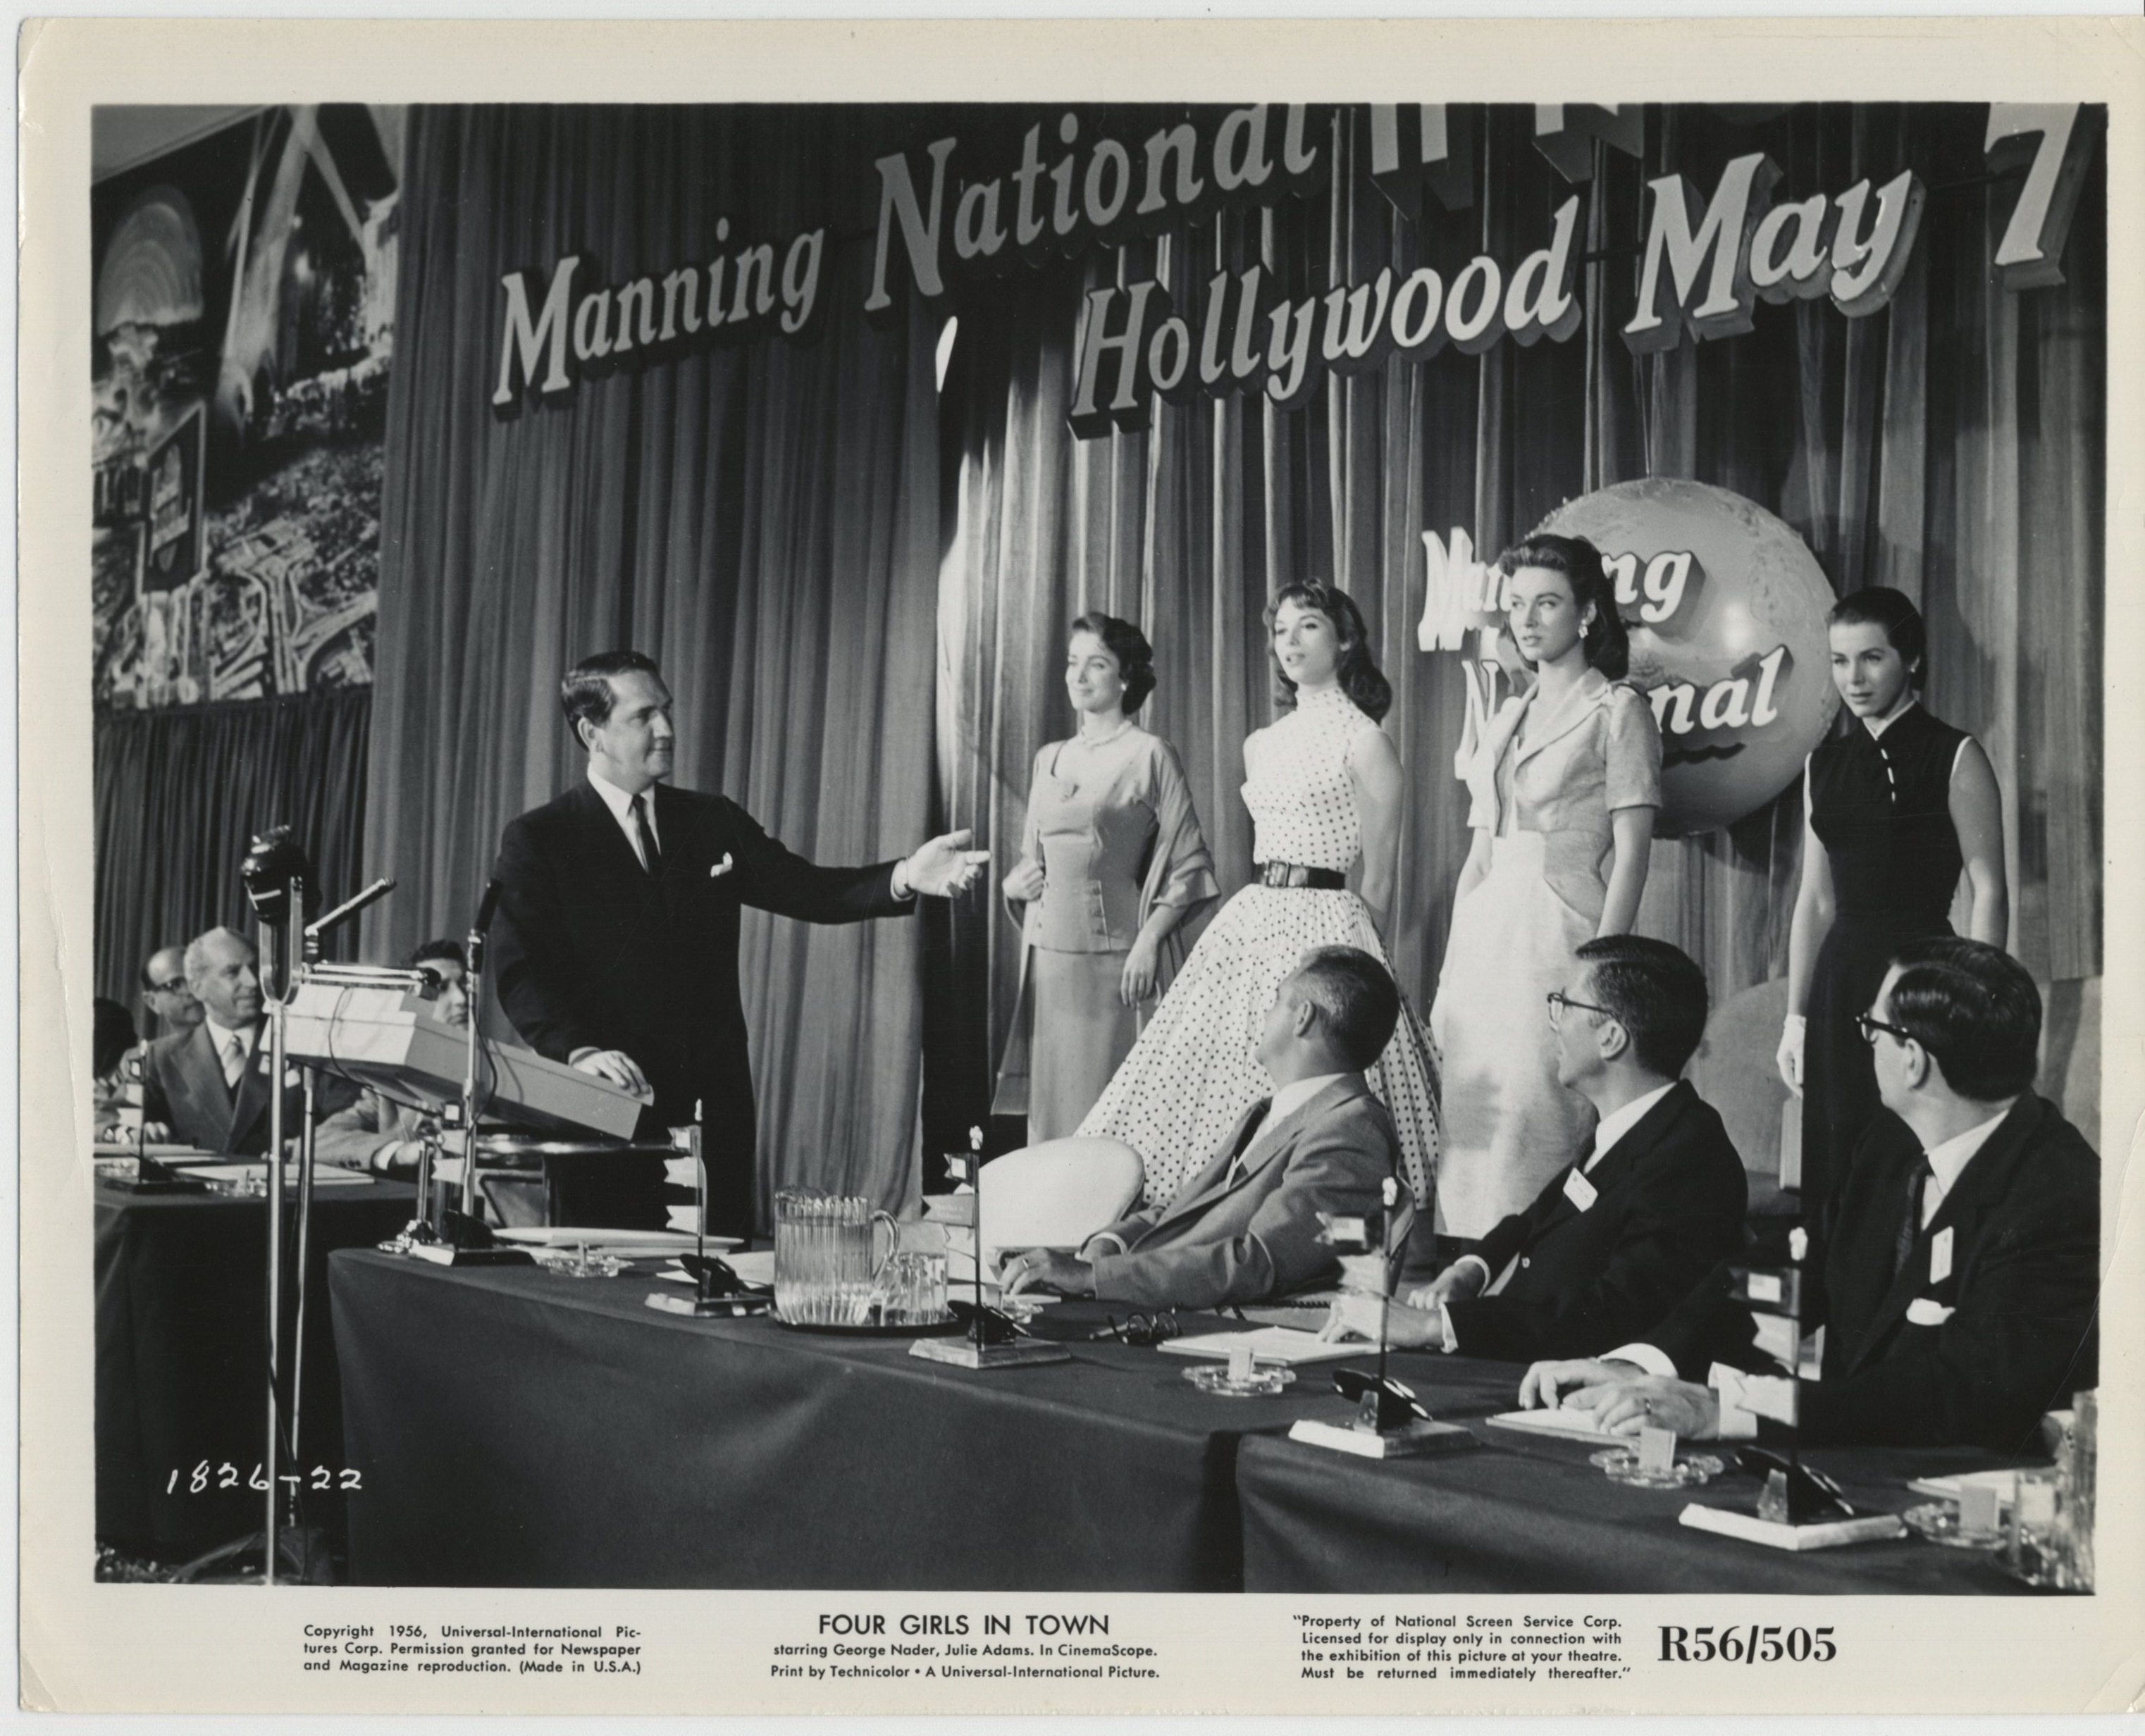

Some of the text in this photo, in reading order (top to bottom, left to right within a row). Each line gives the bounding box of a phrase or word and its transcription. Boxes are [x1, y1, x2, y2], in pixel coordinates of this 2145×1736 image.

[492, 104, 1317, 406] Manning National
[1071, 103, 2082, 417] Hollywood May 7
